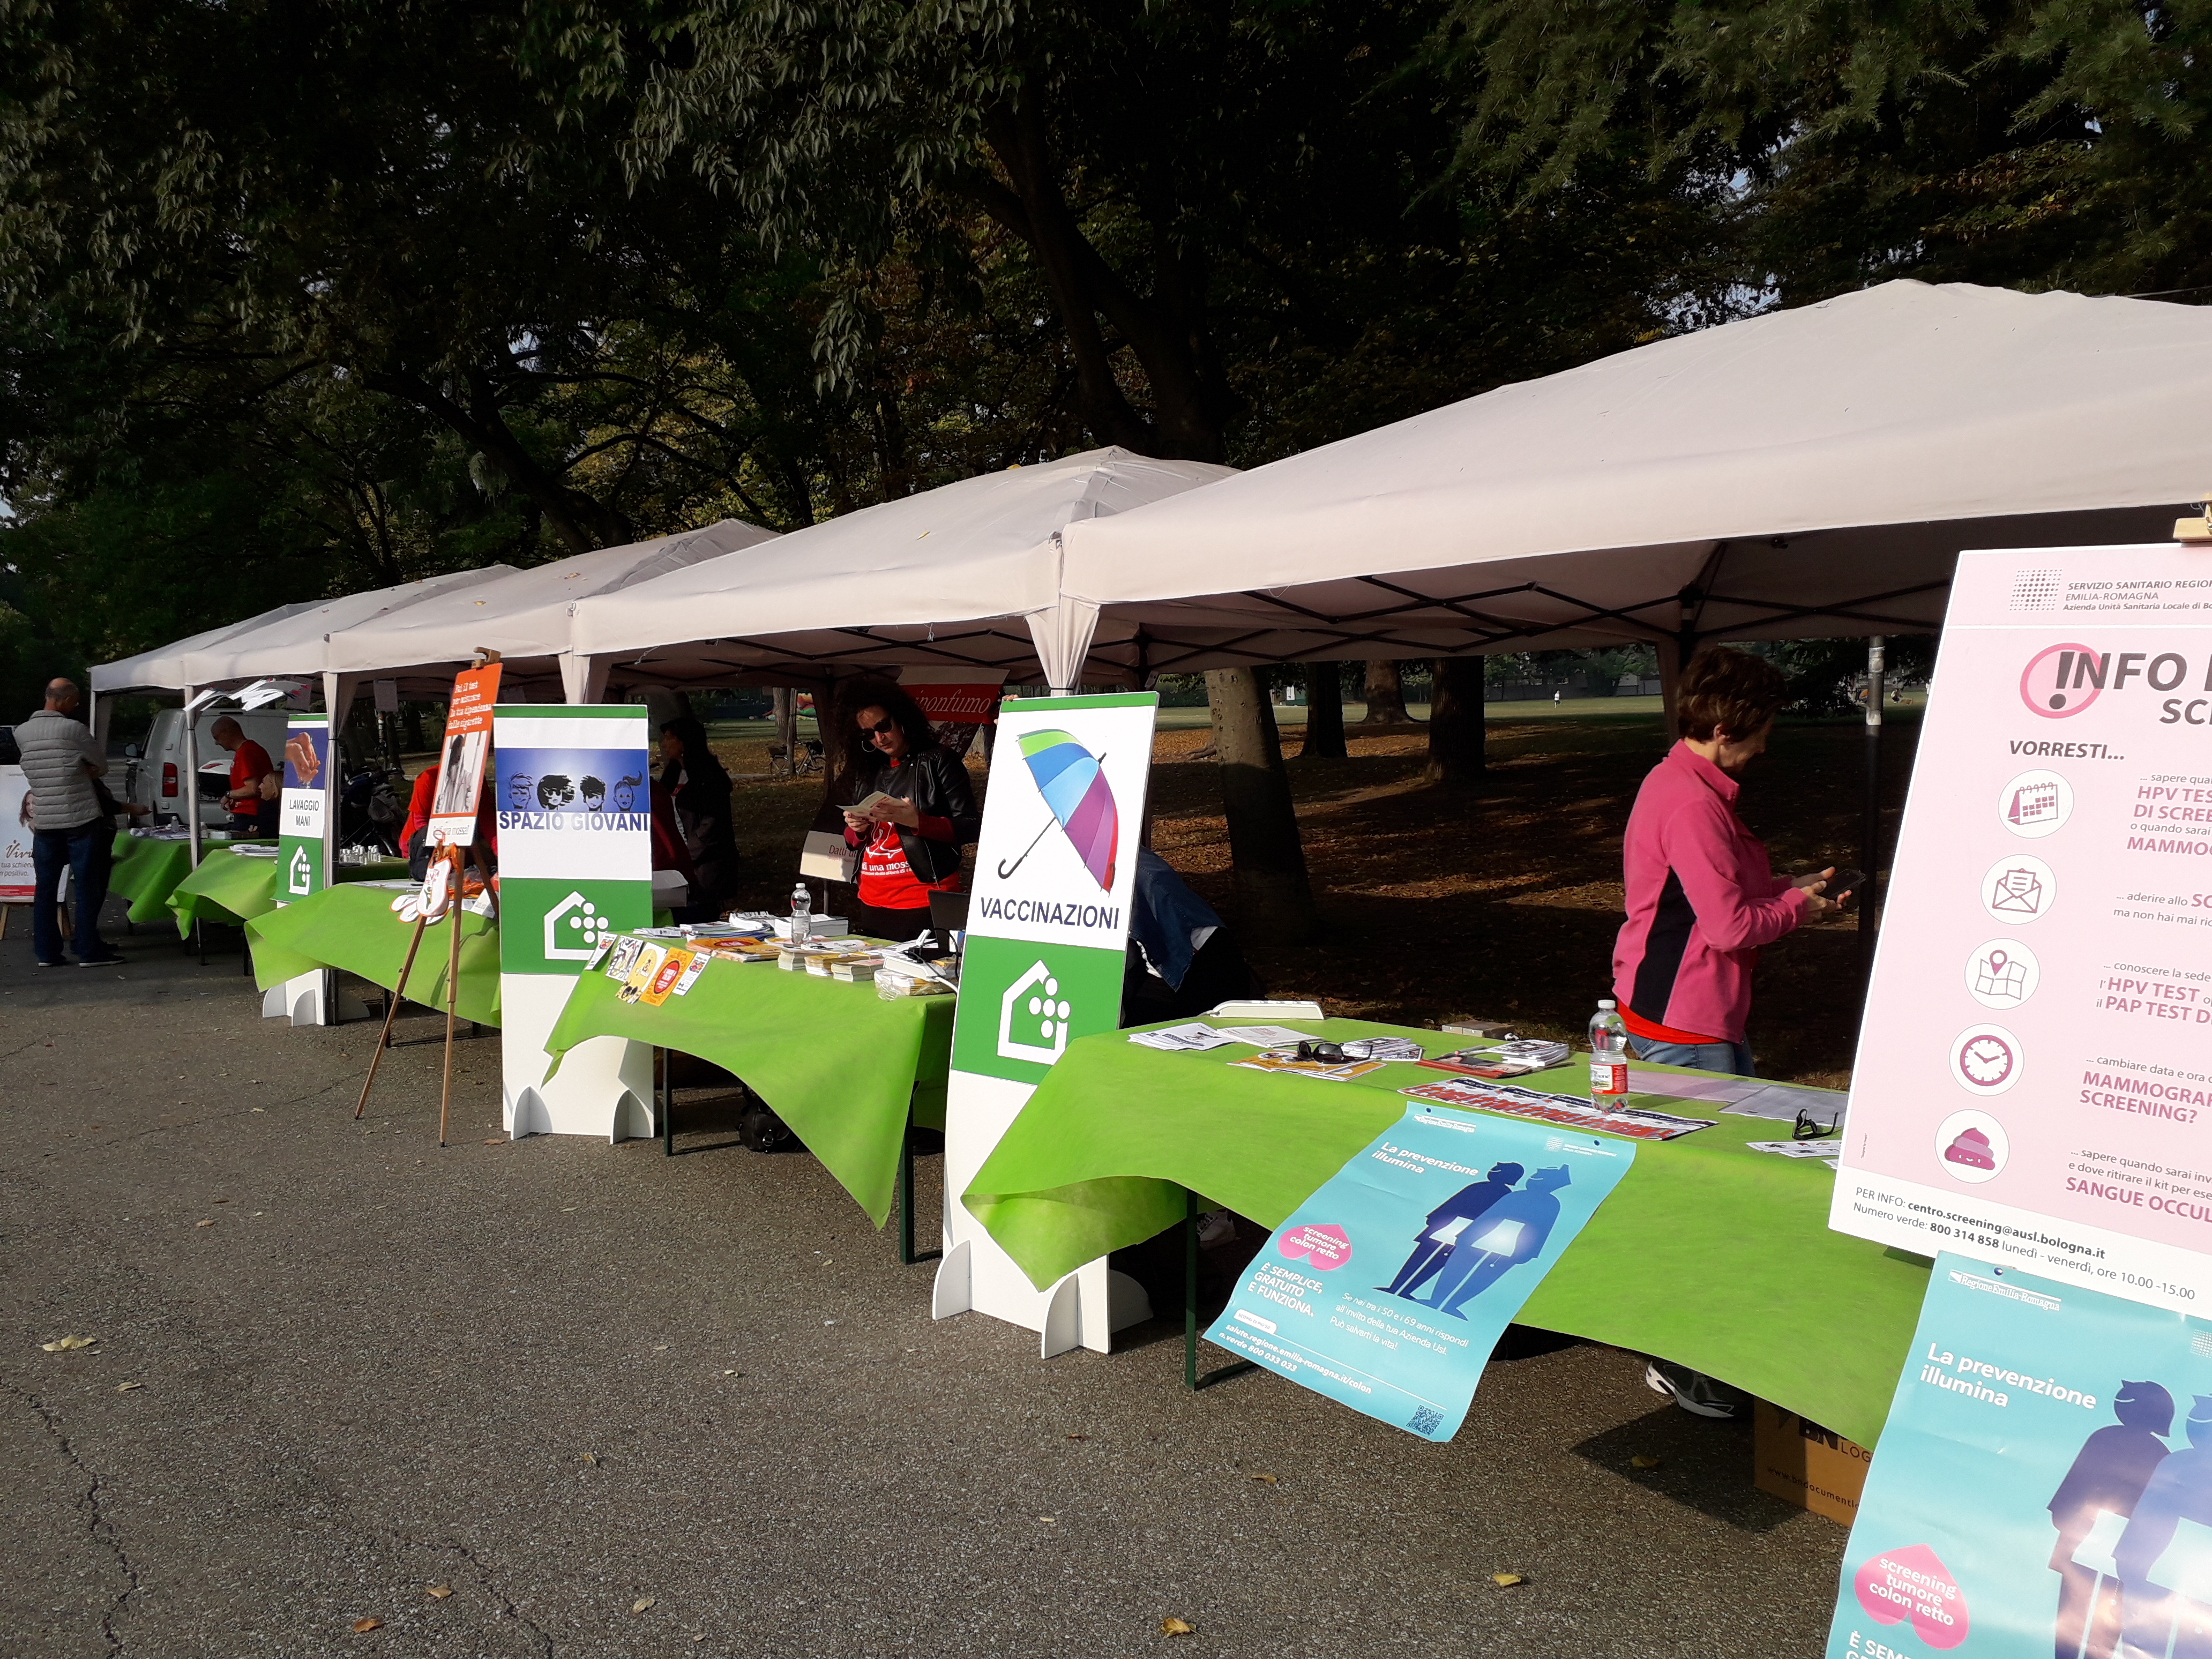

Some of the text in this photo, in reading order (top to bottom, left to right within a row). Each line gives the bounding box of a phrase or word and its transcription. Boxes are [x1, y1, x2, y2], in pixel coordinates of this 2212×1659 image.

[2065, 592, 2158, 601] EMILIA-ROMAGNA
[2068, 582, 2113, 590] SERVIZIO
[2116, 580, 2171, 589] SANITARIO
[2159, 698, 2212, 725] SC
[2009, 740, 2125, 760] VORRESTI...
[2151, 774, 2187, 783] sapere
[289, 799, 319, 811] LAVAGGIO
[2138, 786, 2179, 801] HPV
[296, 815, 311, 826] MANI
[499, 811, 648, 831] SPAZIO GIOVANI
[2133, 804, 2154, 818] DI
[2140, 823, 2183, 833] quando
[2185, 826, 2211, 835] sarai
[2126, 836, 2212, 856] MAMMO
[869, 864, 885, 872] una
[2127, 892, 2165, 903] aderire
[2168, 896, 2188, 906] allo
[981, 897, 1119, 930] VACCINAZIONI
[2133, 911, 2154, 920] non
[2157, 912, 2174, 922] hai
[2177, 916, 2198, 925] mai
[2114, 963, 2211, 982] conoscere la sede
[2153, 983, 2201, 1002] TEST
[2096, 998, 2103, 1008] il
[2105, 996, 2142, 1013] PAP
[2146, 1002, 2193, 1021] TEST
[2097, 1056, 2147, 1072] cambiare
[2149, 1064, 2174, 1077] data
[2187, 1072, 2205, 1082] ora
[2080, 1089, 2198, 1124] SCREENING?
[1371, 1150, 1425, 1174] illumina
[1381, 1141, 1479, 1176] La prevenzione
[2081, 1149, 2117, 1163] sapere
[2119, 1157, 2163, 1173] quando
[2165, 1167, 2192, 1179] sarai
[2078, 1162, 2105, 1176] dove
[2106, 1169, 2143, 1186] ritirare
[2145, 1177, 2151, 1187] il
[2155, 1179, 2169, 1191] kit
[2171, 1184, 2191, 1195] per
[2065, 1177, 2144, 1207] SANGUE
[1856, 1186, 2106, 1259] PER INFO: centro.screening@ausl.bologna.it
[1289, 1236, 1339, 1260] colon retto
[1303, 1226, 1350, 1250] screening
[1303, 1233, 1337, 1251] tumore
[1853, 1201, 1894, 1221] Numero
[1896, 1214, 1928, 1230] verde:
[1930, 1222, 1951, 1236] 800
[1954, 1228, 1975, 1242] 314
[1977, 1235, 1999, 1249] 858
[2002, 1239, 2038, 1259] lunedì
[2047, 1253, 2094, 1275] venerdì,
[2097, 1267, 2117, 1280] ore
[2121, 1272, 2154, 1289] 10.00
[1254, 1272, 1305, 1297] GRATUITO
[1260, 1261, 1324, 1295] È SEMPLICE,
[1247, 1281, 1314, 1317] E FUNZIONA.
[1330, 1315, 1399, 1350] Può salvarti la vita!
[1335, 1304, 1447, 1356] all'invito della tua Azienda Usl.
[1342, 1292, 1353, 1302] Se
[1352, 1297, 1365, 1306] hai
[1366, 1301, 1377, 1311] tra
[1381, 1307, 1394, 1318] 50
[1404, 1316, 1416, 1326] 69
[1416, 1322, 1436, 1334] anni
[1435, 1330, 1469, 1348] rispondi
[1219, 1332, 1298, 1372] n.verde 800 033 033
[1225, 1324, 1372, 1394] salute.regione.emilia-romagna.it/colon
[1919, 1364, 2009, 1408] illumina
[1927, 1342, 2097, 1410] La prevenzione
[1879, 1557, 1957, 1601] screening
[1886, 1573, 1943, 1606] tumore
[1869, 1582, 1955, 1627] colon retto
[1849, 1630, 1862, 1649] È
